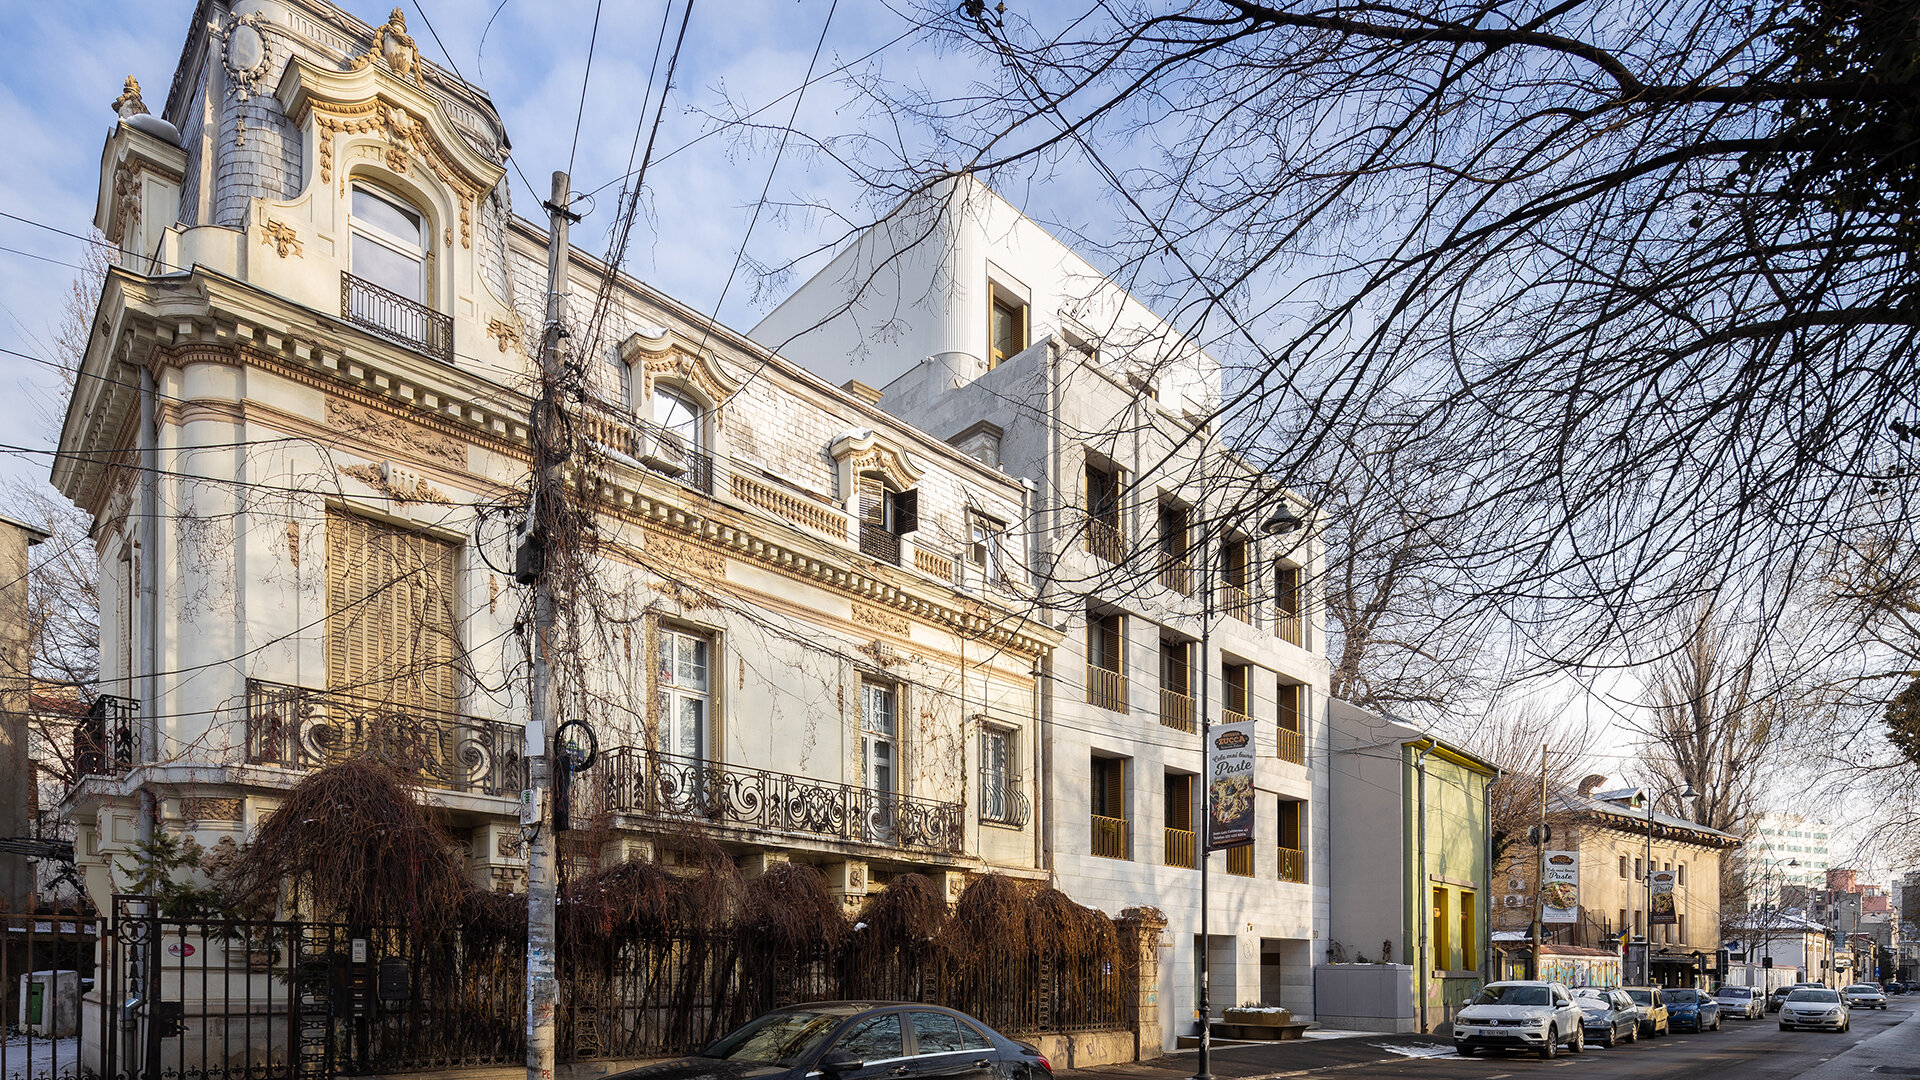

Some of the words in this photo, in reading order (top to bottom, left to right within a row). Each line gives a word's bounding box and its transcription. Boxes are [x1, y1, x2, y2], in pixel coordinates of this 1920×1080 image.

[1218, 735, 1245, 745] ZUCCA
[1214, 760, 1252, 776] Paste
[1549, 871, 1573, 880] Paste
